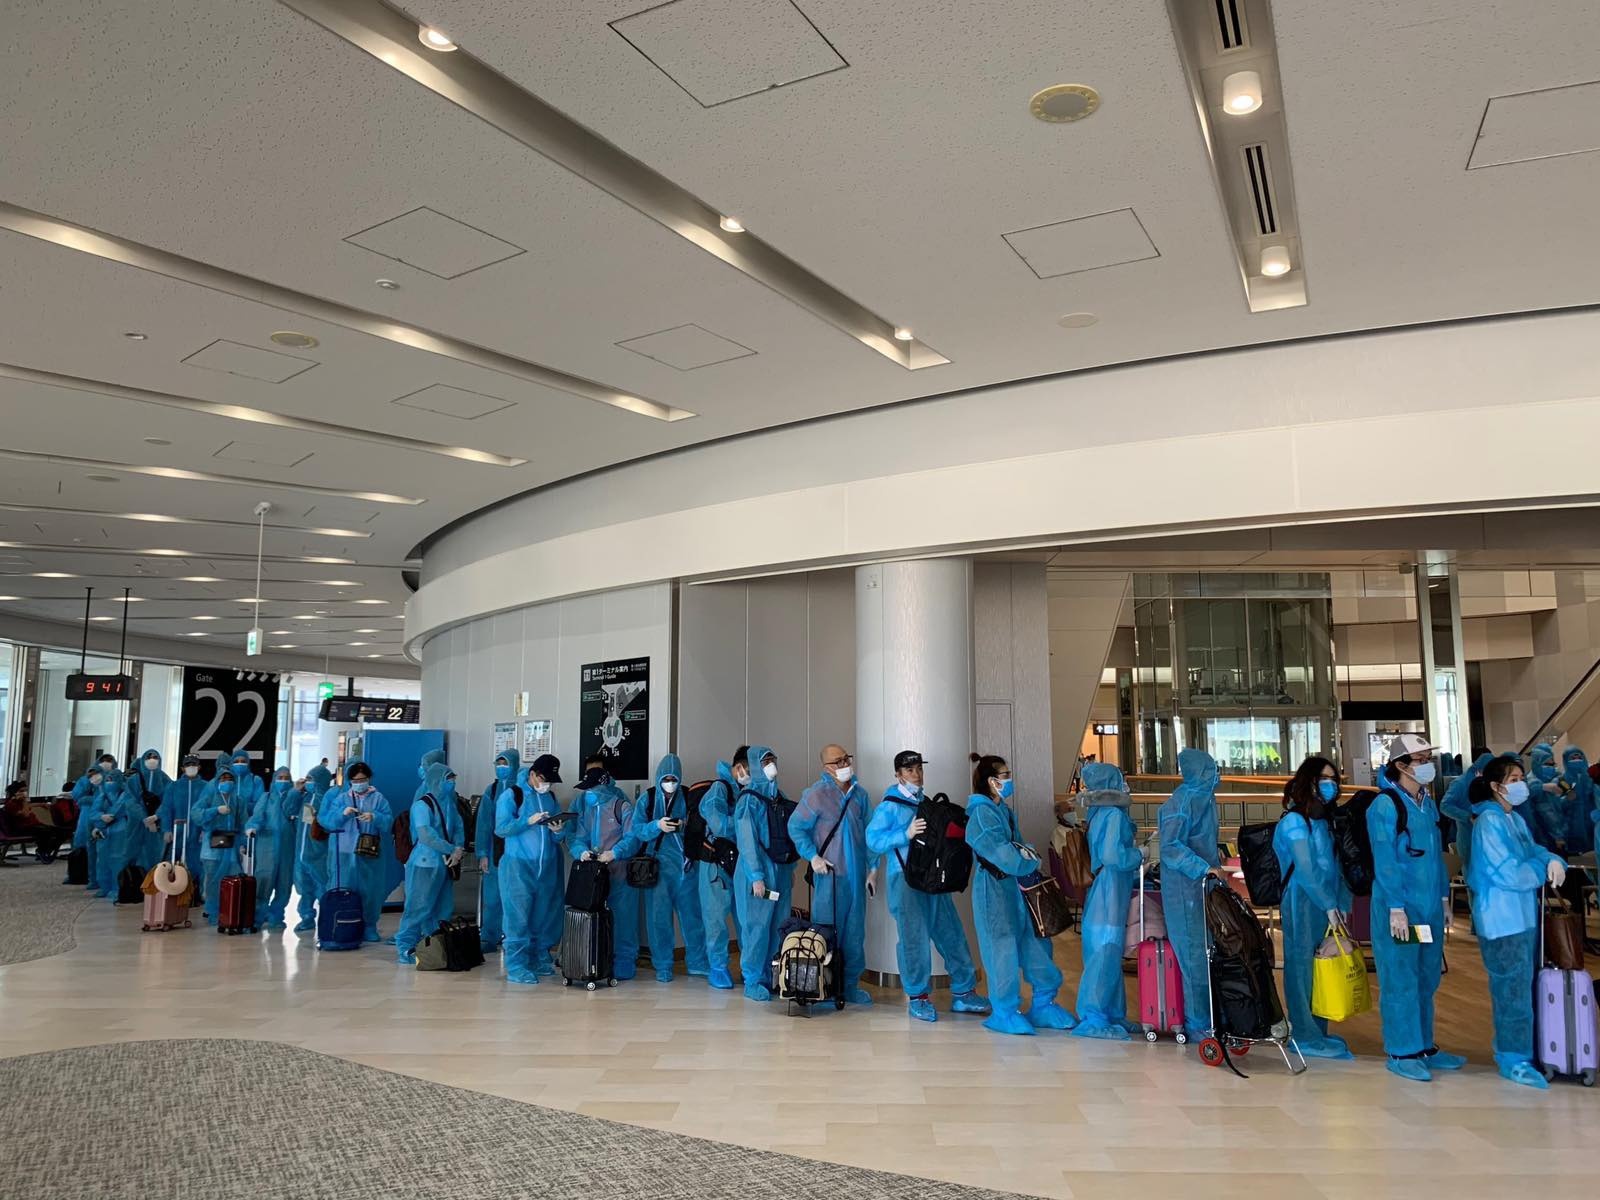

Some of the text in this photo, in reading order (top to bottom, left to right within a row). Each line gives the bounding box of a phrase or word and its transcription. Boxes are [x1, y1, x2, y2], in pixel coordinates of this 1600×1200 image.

[196, 673, 213, 683] Gate
[387, 707, 403, 720] 22
[190, 687, 266, 760] 22
